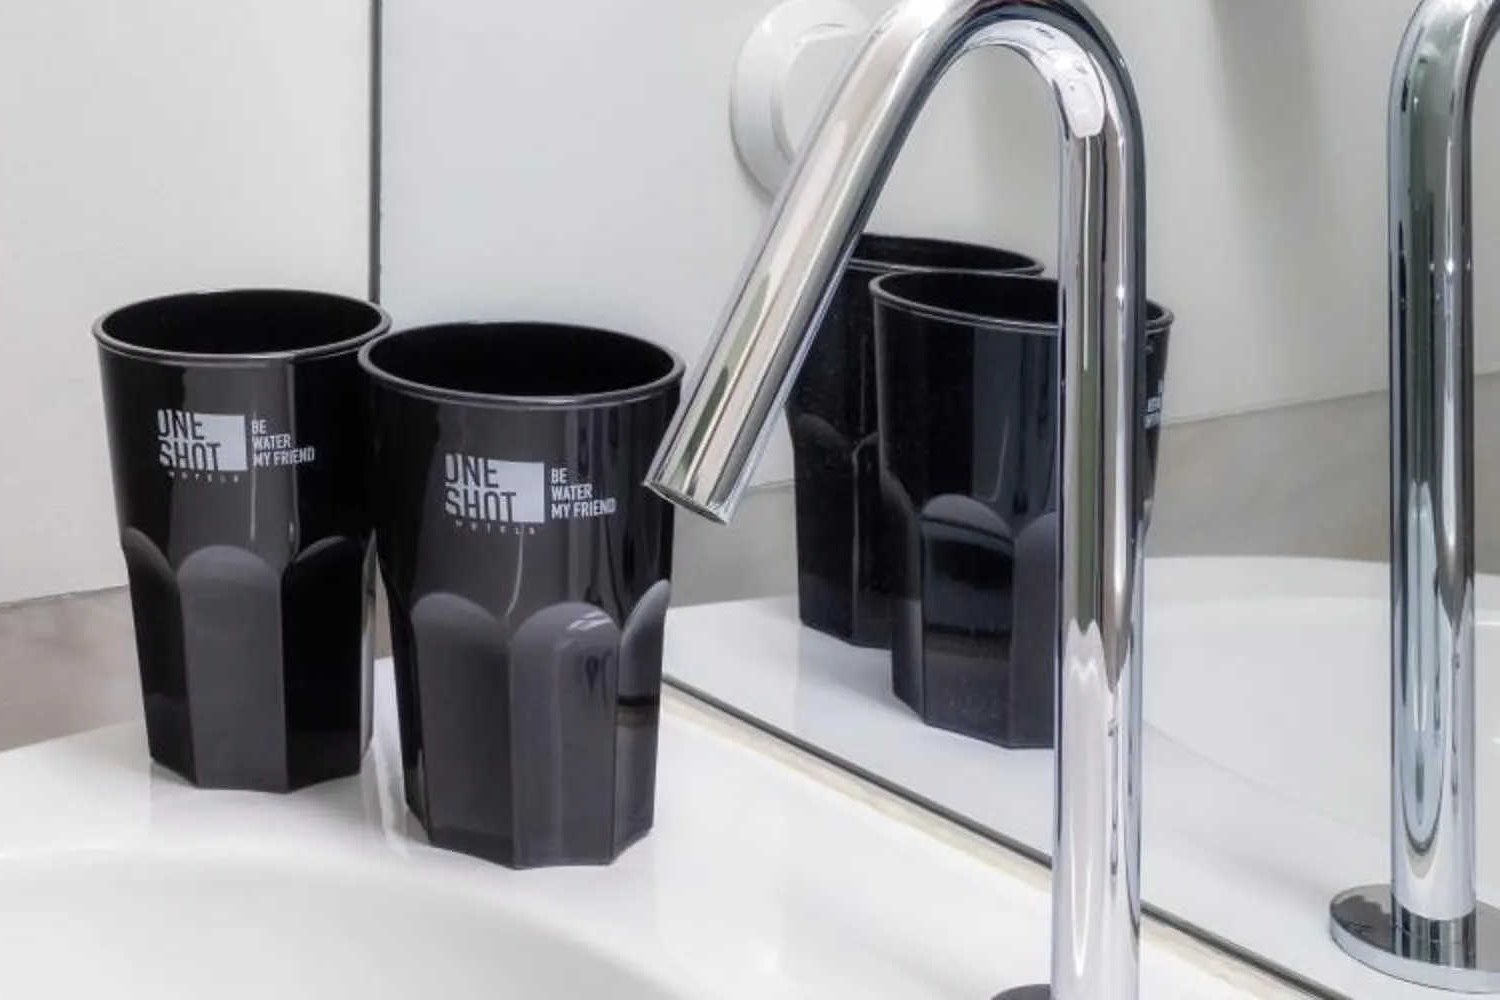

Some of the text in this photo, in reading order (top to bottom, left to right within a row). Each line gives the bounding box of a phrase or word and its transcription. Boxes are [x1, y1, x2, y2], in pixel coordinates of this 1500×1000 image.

[157, 408, 205, 440] ONE
[251, 419, 267, 434] BE
[251, 433, 292, 450] WATER
[158, 440, 222, 471] SHOT
[252, 446, 316, 467] MY FRIEND
[445, 452, 499, 488] ONE
[551, 467, 567, 484] BE
[551, 483, 593, 501] WATER
[445, 486, 517, 522] SHOT
[551, 497, 617, 519] MY FRIEND
